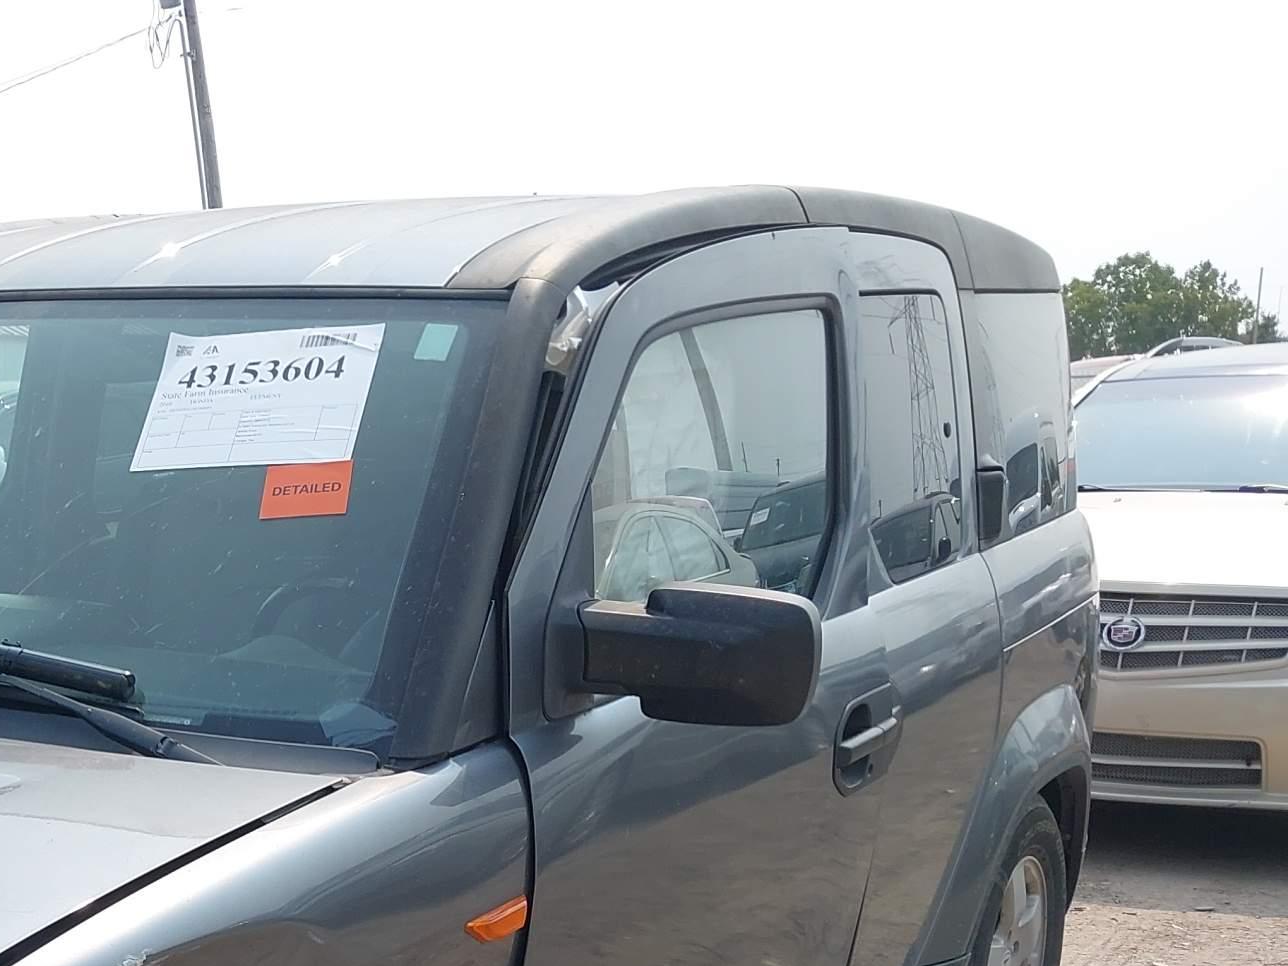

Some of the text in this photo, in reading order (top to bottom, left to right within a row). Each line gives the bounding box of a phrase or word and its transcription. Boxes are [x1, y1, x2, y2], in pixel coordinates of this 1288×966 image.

[177, 354, 346, 389] 43153604
[162, 387, 249, 400] State Farm Insurance
[272, 482, 342, 497] DETAILED
